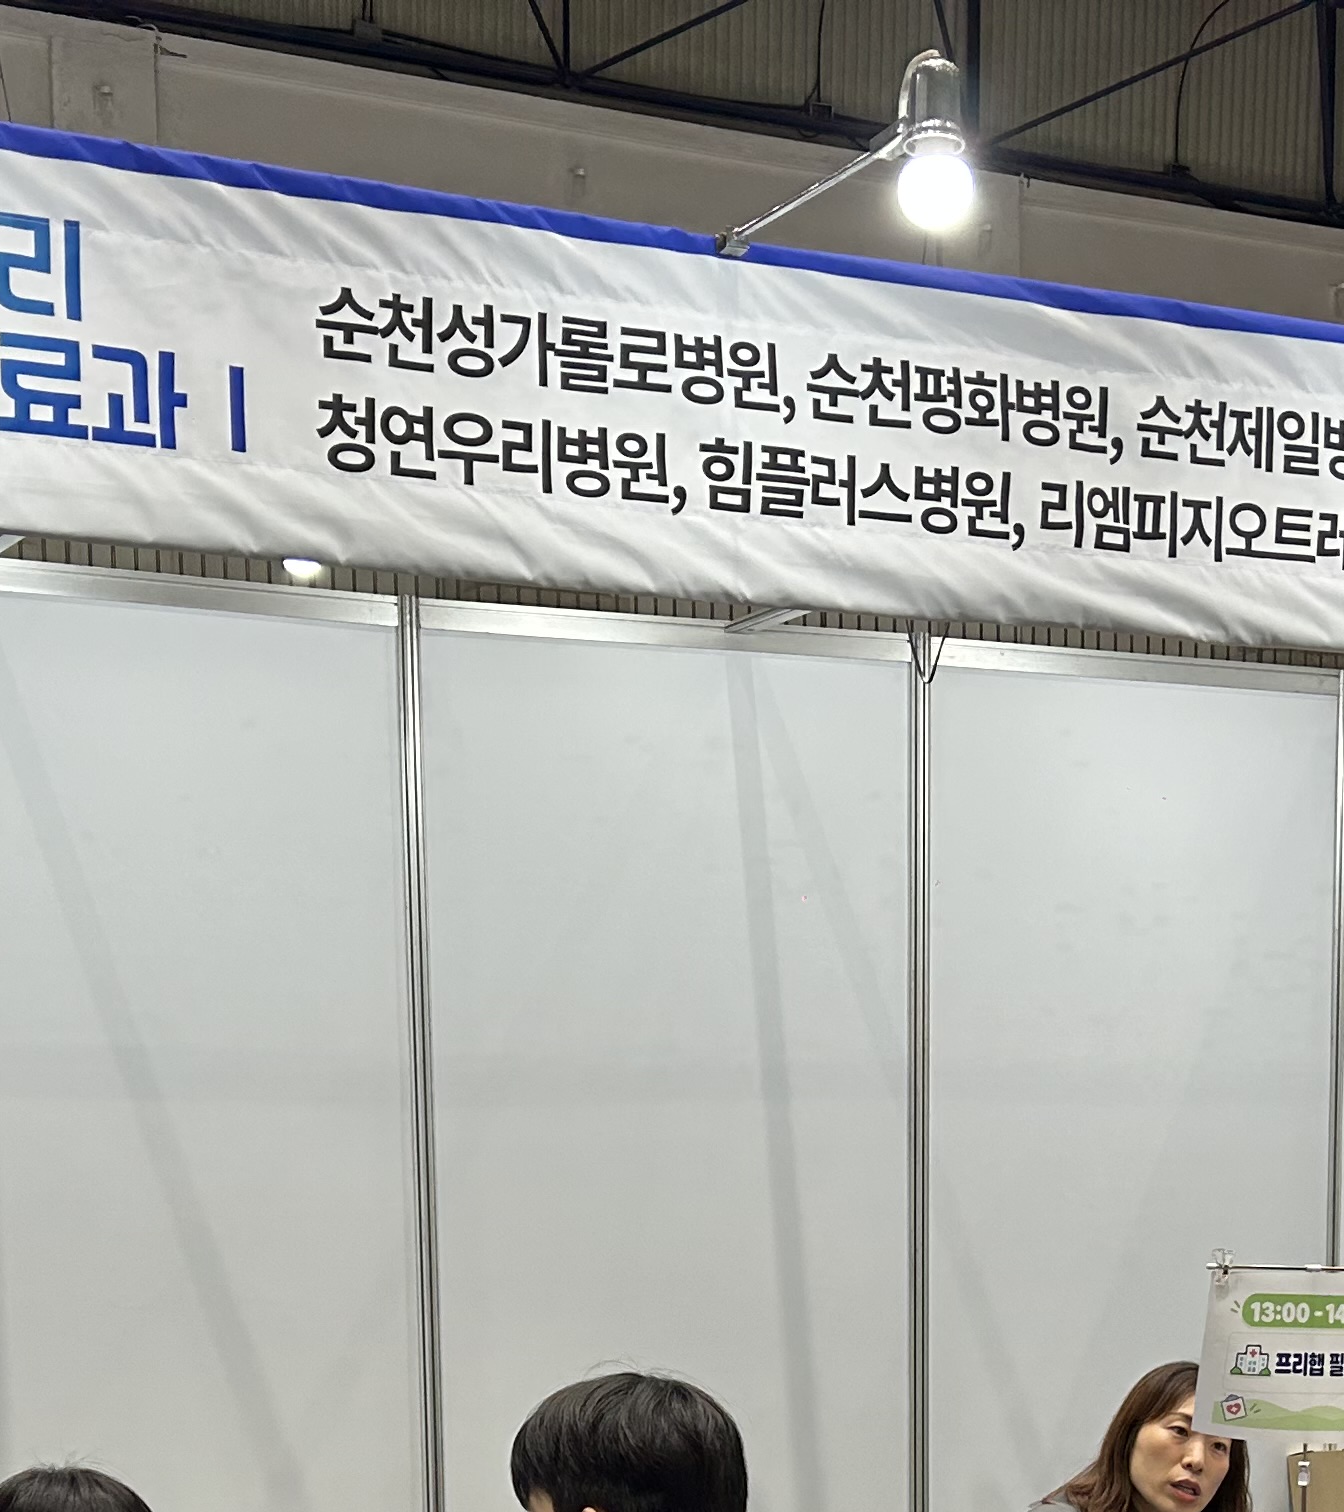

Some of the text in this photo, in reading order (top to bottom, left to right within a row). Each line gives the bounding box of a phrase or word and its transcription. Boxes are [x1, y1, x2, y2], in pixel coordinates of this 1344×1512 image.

[315, 285, 797, 424] 순천성가롤로병원,
[805, 350, 1124, 465] 순천평화병원,
[315, 392, 688, 516] 청연우리병원,
[697, 436, 1026, 551] 힘플러스병원,
[1250, 1301, 1310, 1323] 13:00
